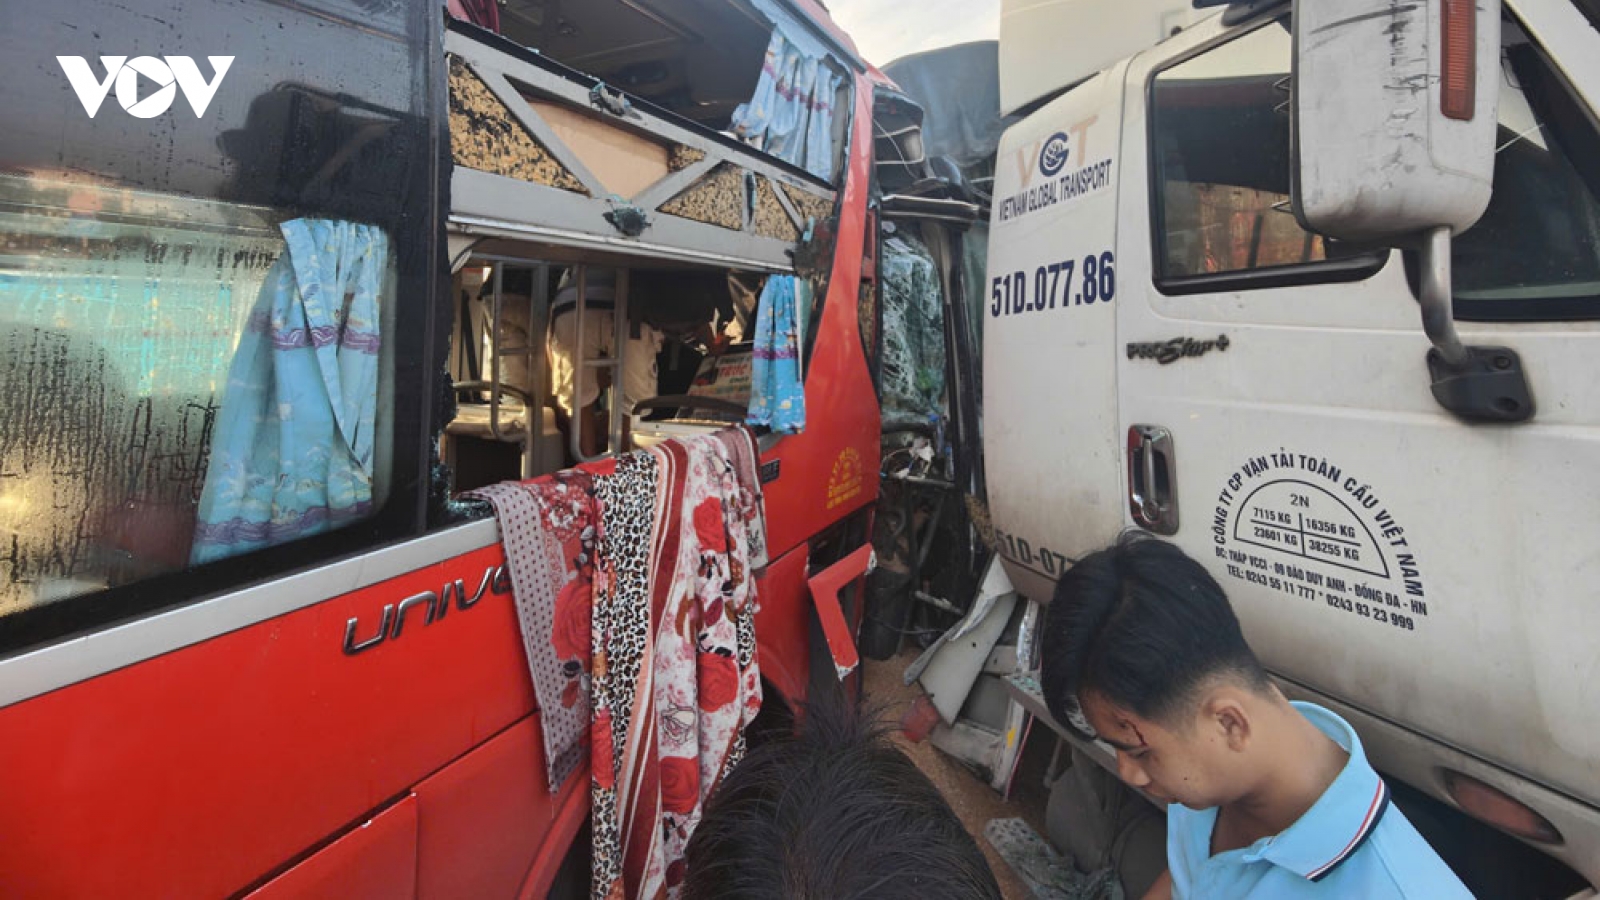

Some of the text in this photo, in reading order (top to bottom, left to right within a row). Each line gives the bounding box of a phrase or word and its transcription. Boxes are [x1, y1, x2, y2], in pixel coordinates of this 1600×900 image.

[1028, 180, 1057, 212] GLOBAL
[1060, 159, 1112, 202] TRANSPORT
[991, 251, 1115, 317] 51D.077.86
[1242, 456, 1269, 478] VẬN
[1270, 447, 1294, 468] TẢI
[1299, 455, 1341, 483] TOÀN
[1228, 472, 1243, 491] CP
[1219, 489, 1233, 507] TY
[1290, 493, 1310, 508] 2N
[1211, 506, 1228, 545] CÔNG
[1253, 508, 1291, 524] 7115 KG
[1254, 527, 1298, 546] 23601 KG
[1305, 518, 1355, 538] 16356 KG
[1374, 509, 1408, 547] VIỆT
[1308, 540, 1360, 561] 38255 KG
[1249, 555, 1267, 570] VCCI
[1306, 570, 1323, 586] DUY
[1326, 576, 1346, 593] ANH
[1385, 592, 1400, 609] ĐA
[1410, 599, 1427, 616] HN
[1396, 554, 1424, 597] NAM
[1227, 564, 1414, 631] TEL: 0243 55 11 777 0243 93 23 999
